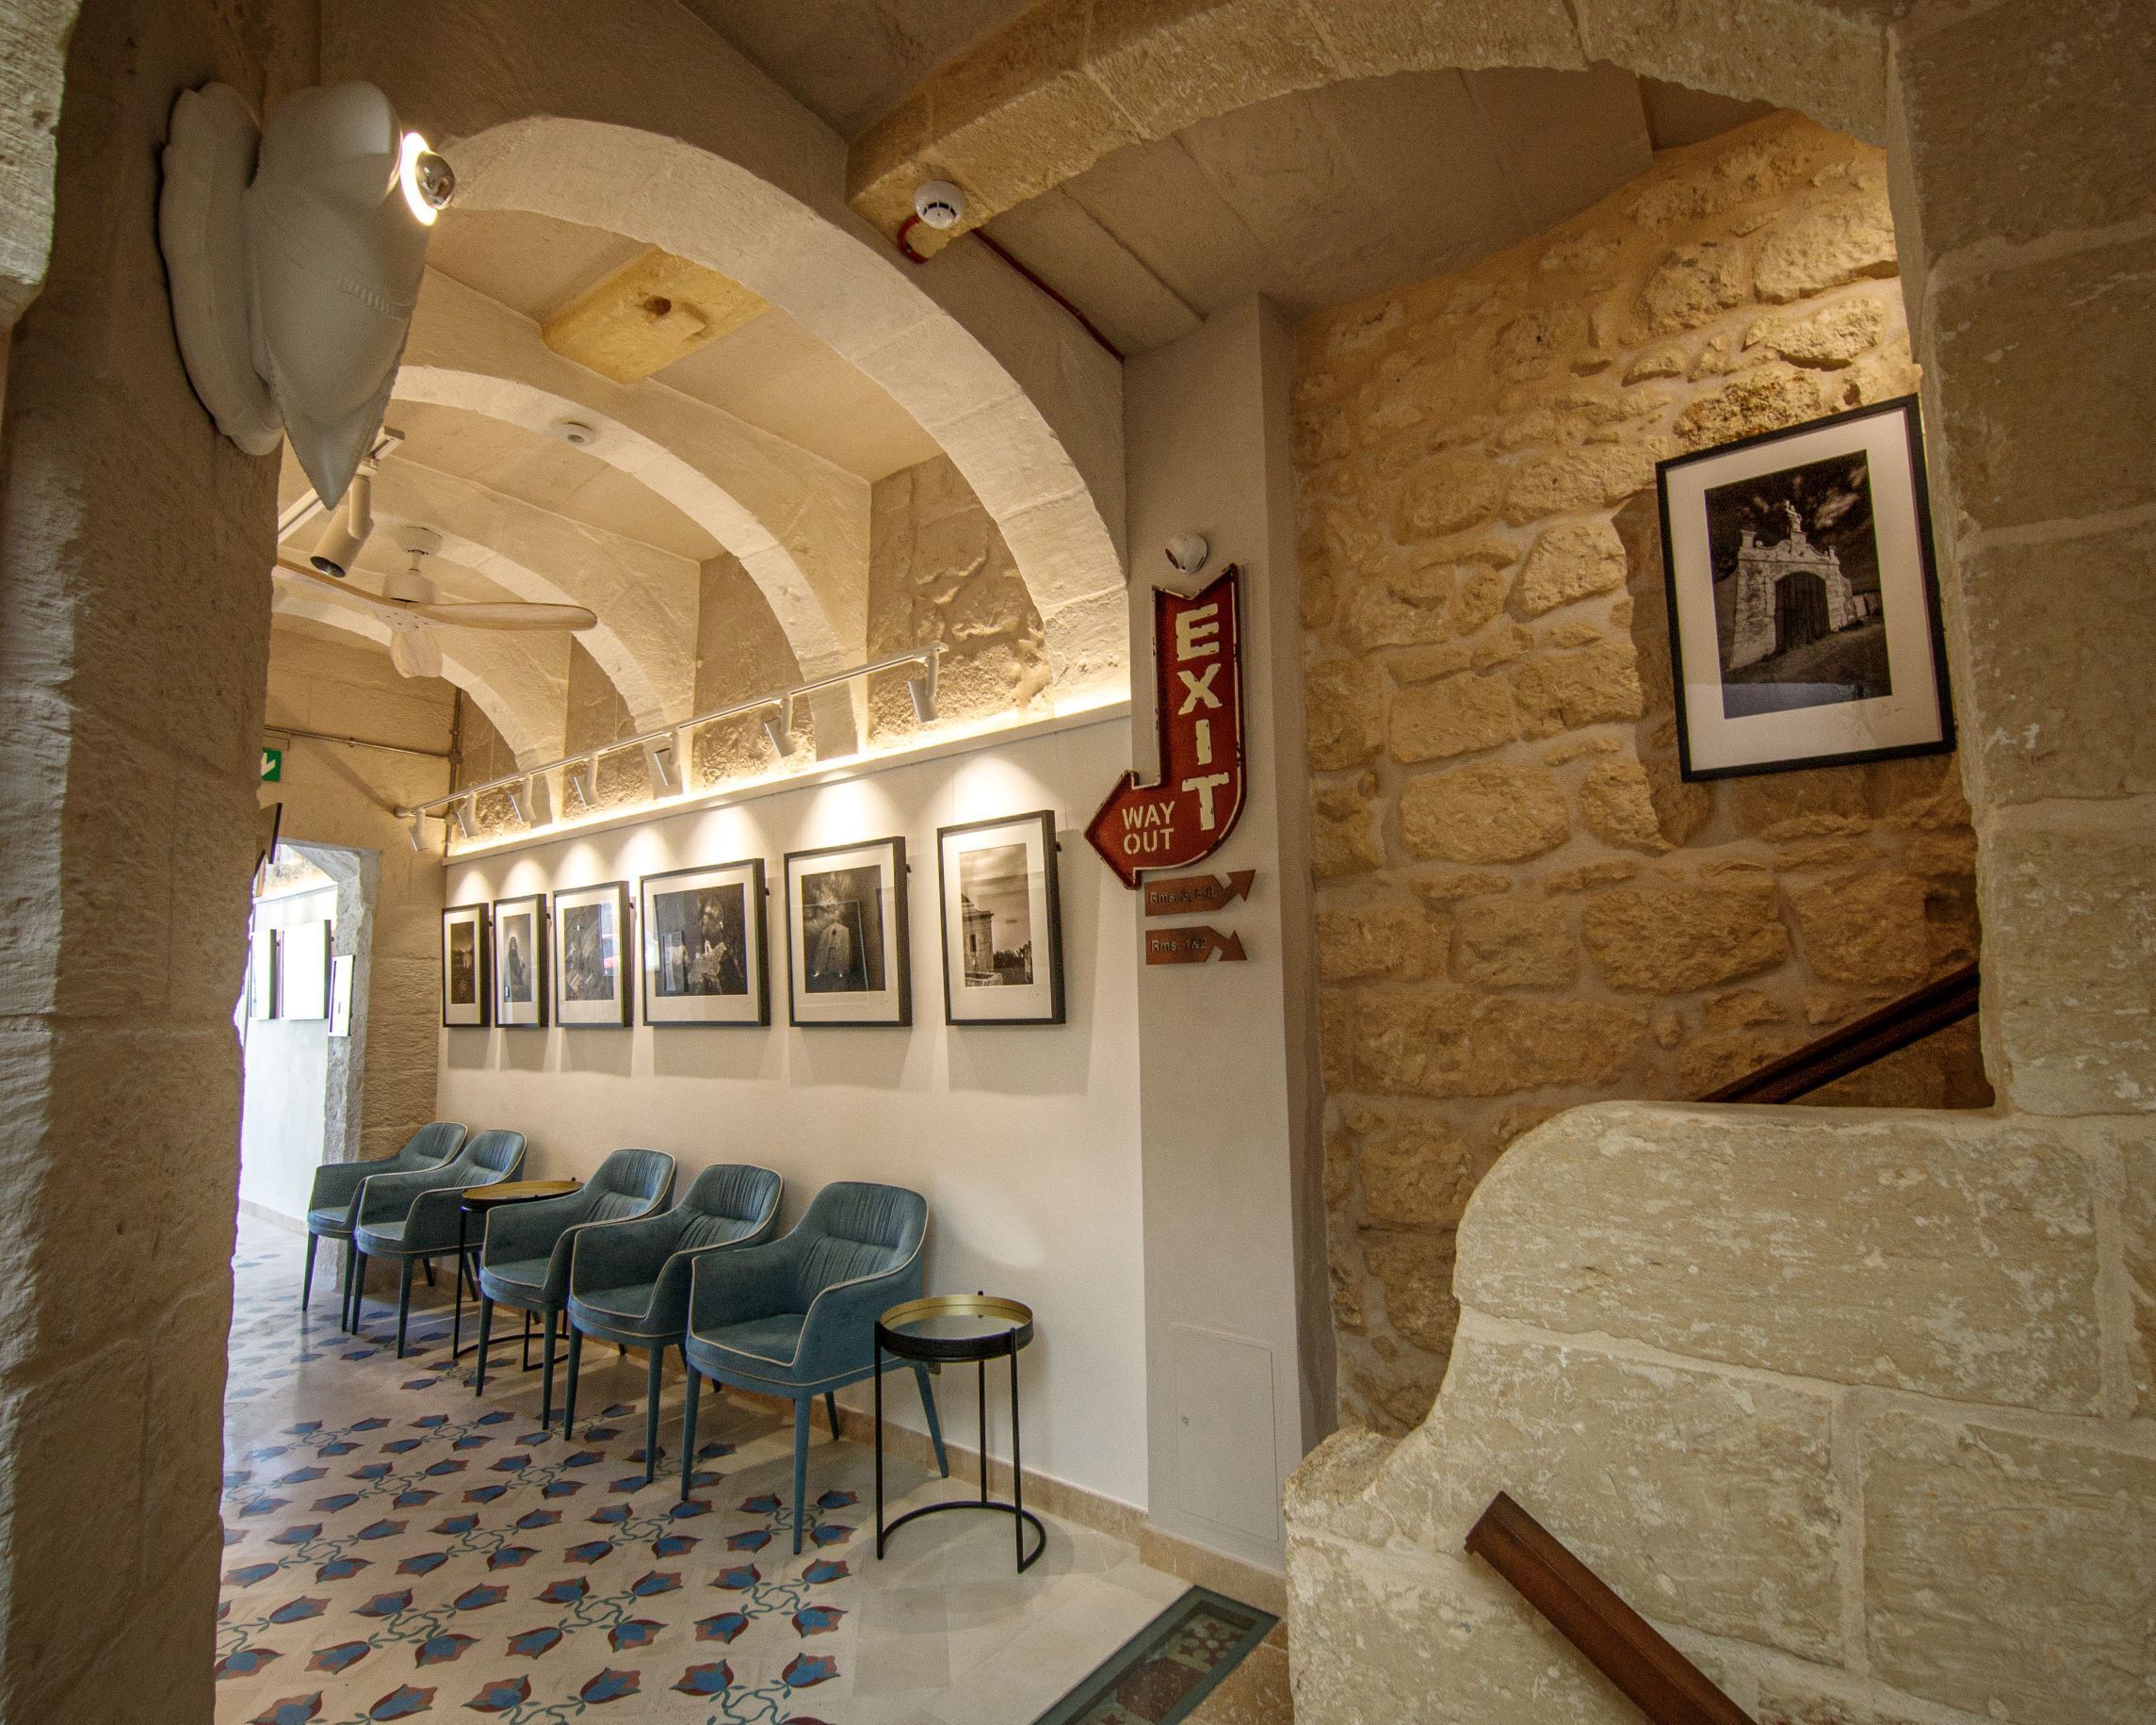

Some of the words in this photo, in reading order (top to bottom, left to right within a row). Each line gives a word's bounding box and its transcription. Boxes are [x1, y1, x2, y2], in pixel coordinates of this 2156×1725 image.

[1175, 603, 1229, 830] EXIT
[1122, 801, 1175, 830] WAY
[1123, 828, 1175, 854] OUT
